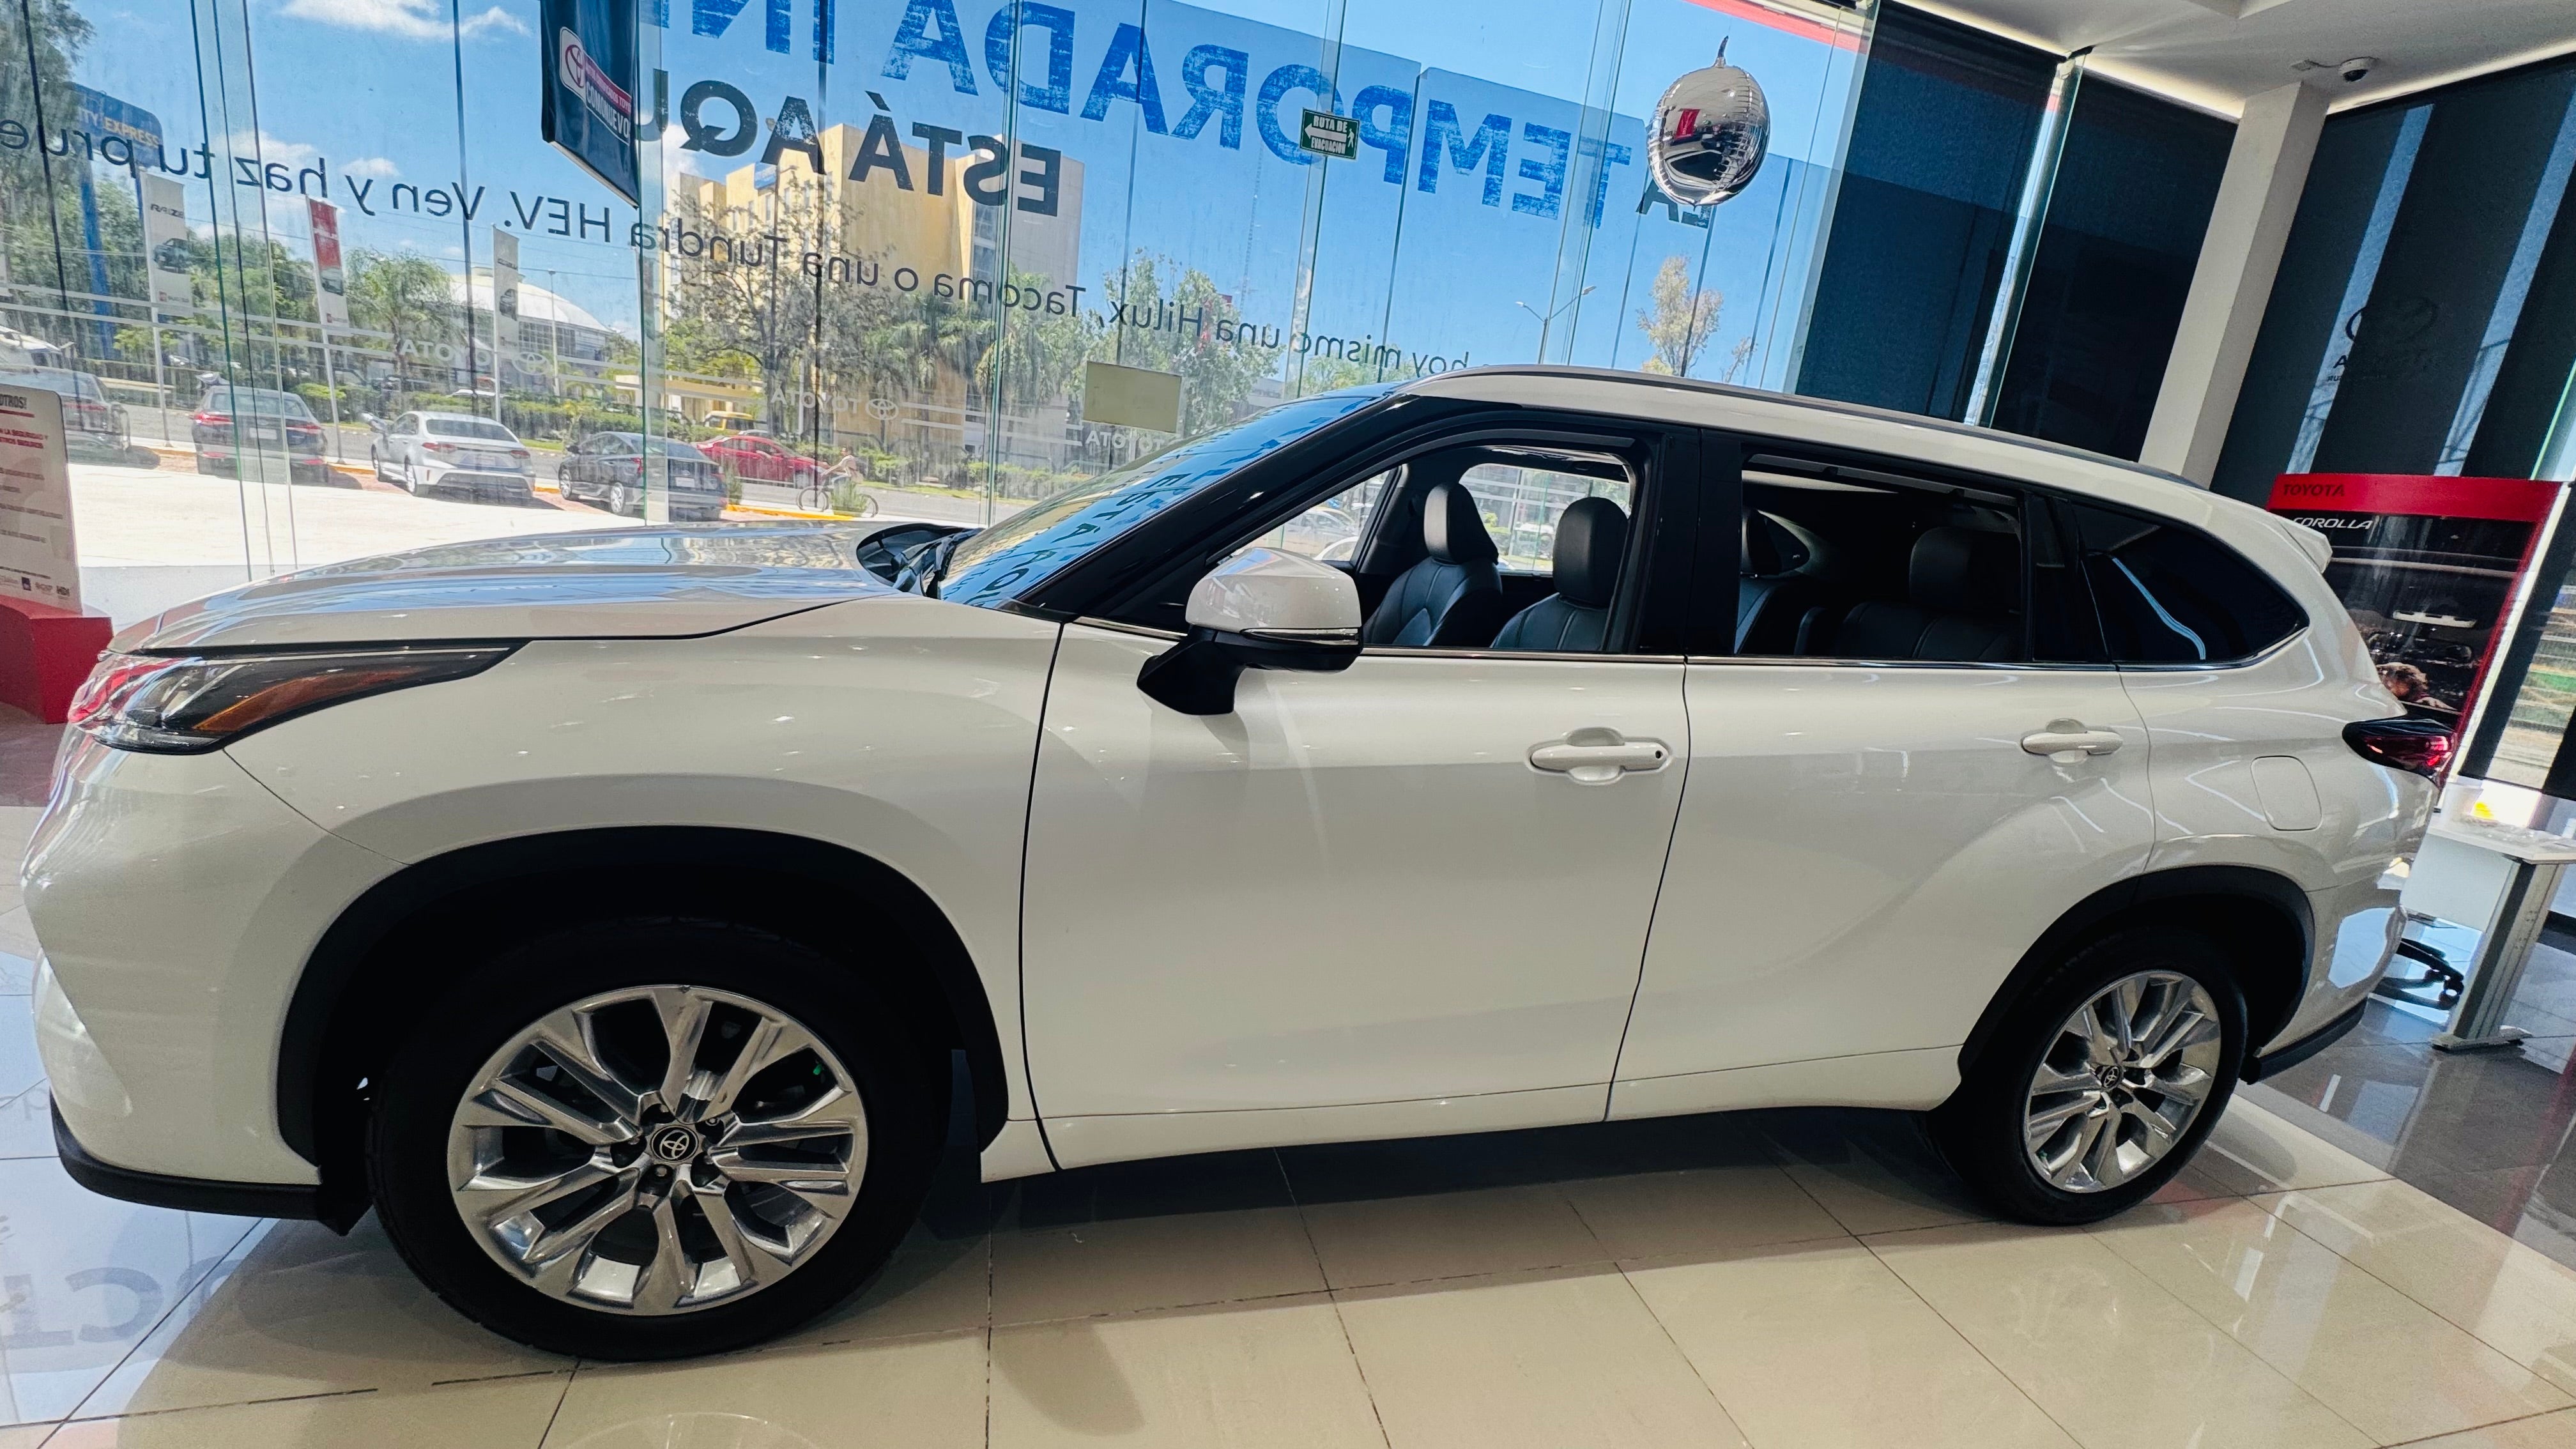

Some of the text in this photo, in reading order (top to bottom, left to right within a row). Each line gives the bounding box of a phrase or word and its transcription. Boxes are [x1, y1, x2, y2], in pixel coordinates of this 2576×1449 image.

[103, 117, 161, 147] EXPRESS
[1313, 115, 1347, 133] RUTA DE
[1311, 137, 1346, 154] EVACUACION
[2283, 484, 2345, 497] TOYOTA
